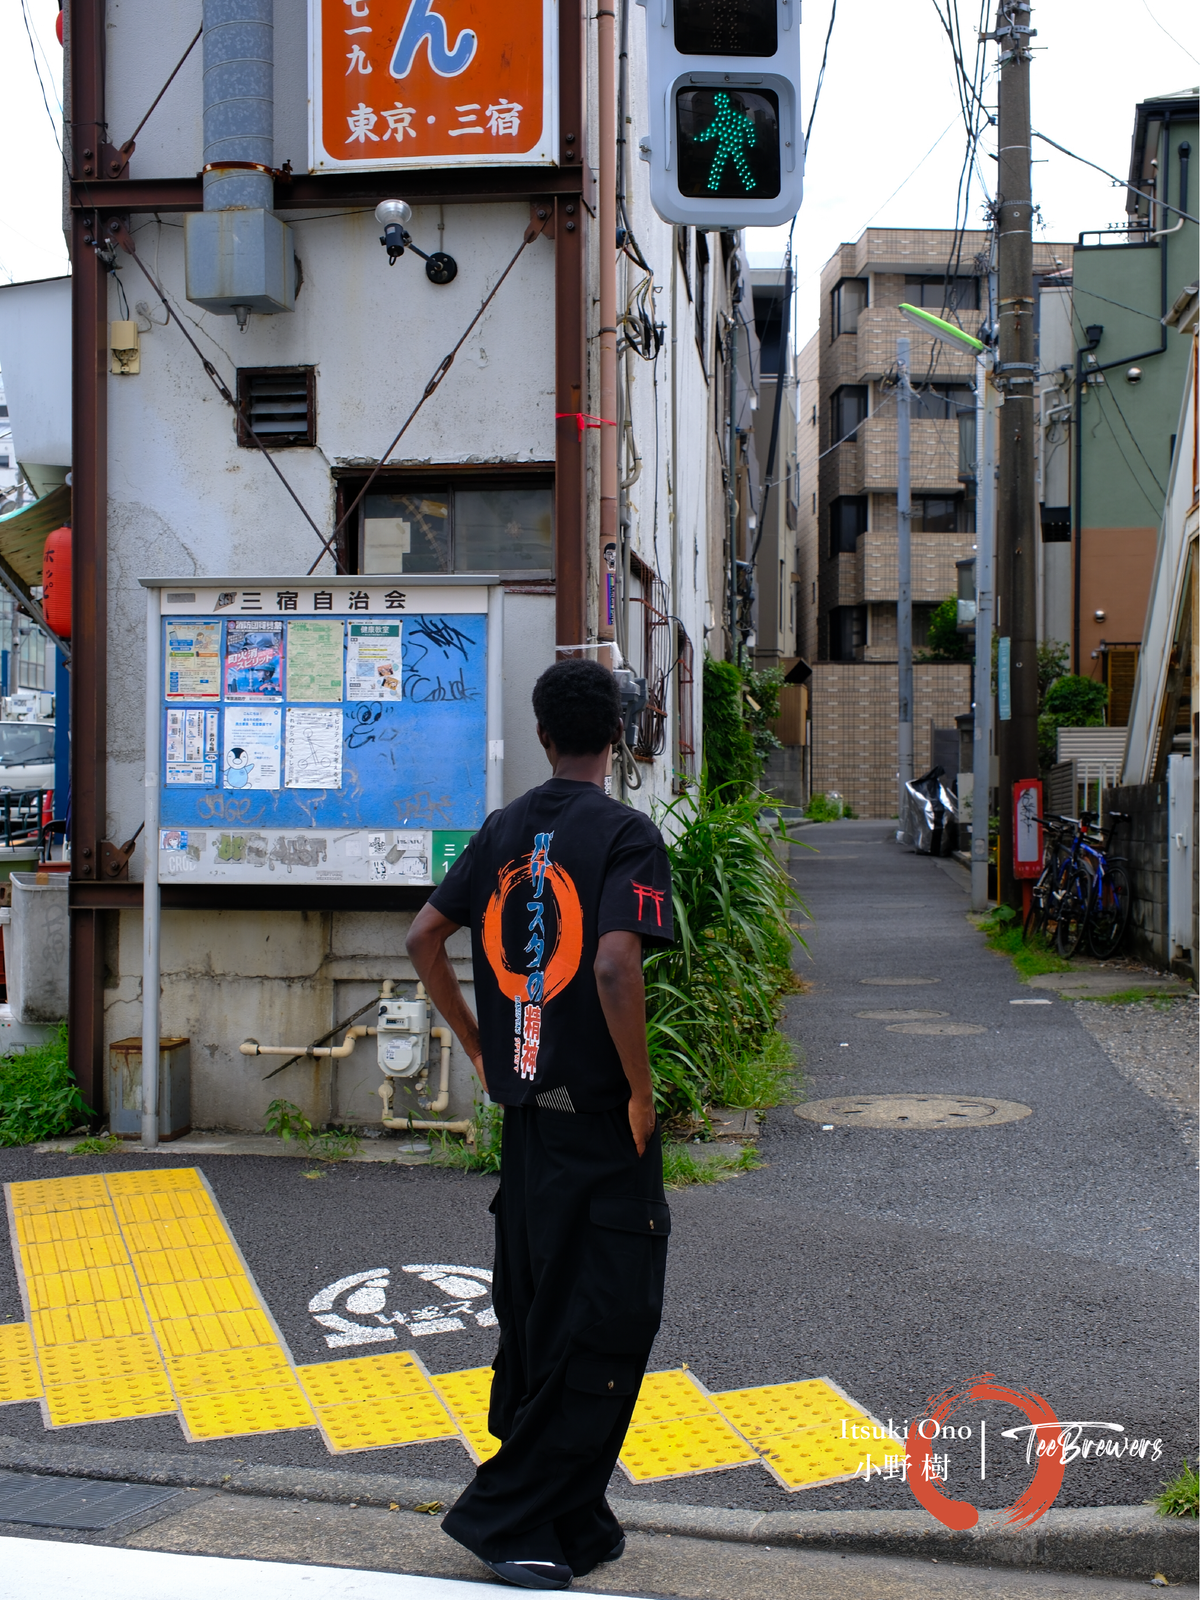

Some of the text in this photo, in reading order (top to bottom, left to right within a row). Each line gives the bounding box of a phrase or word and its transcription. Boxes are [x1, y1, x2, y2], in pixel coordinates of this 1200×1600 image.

[389, 0, 478, 79] ん
[344, 98, 524, 144] 東京・三宿
[240, 590, 407, 611] 三宿自治会
